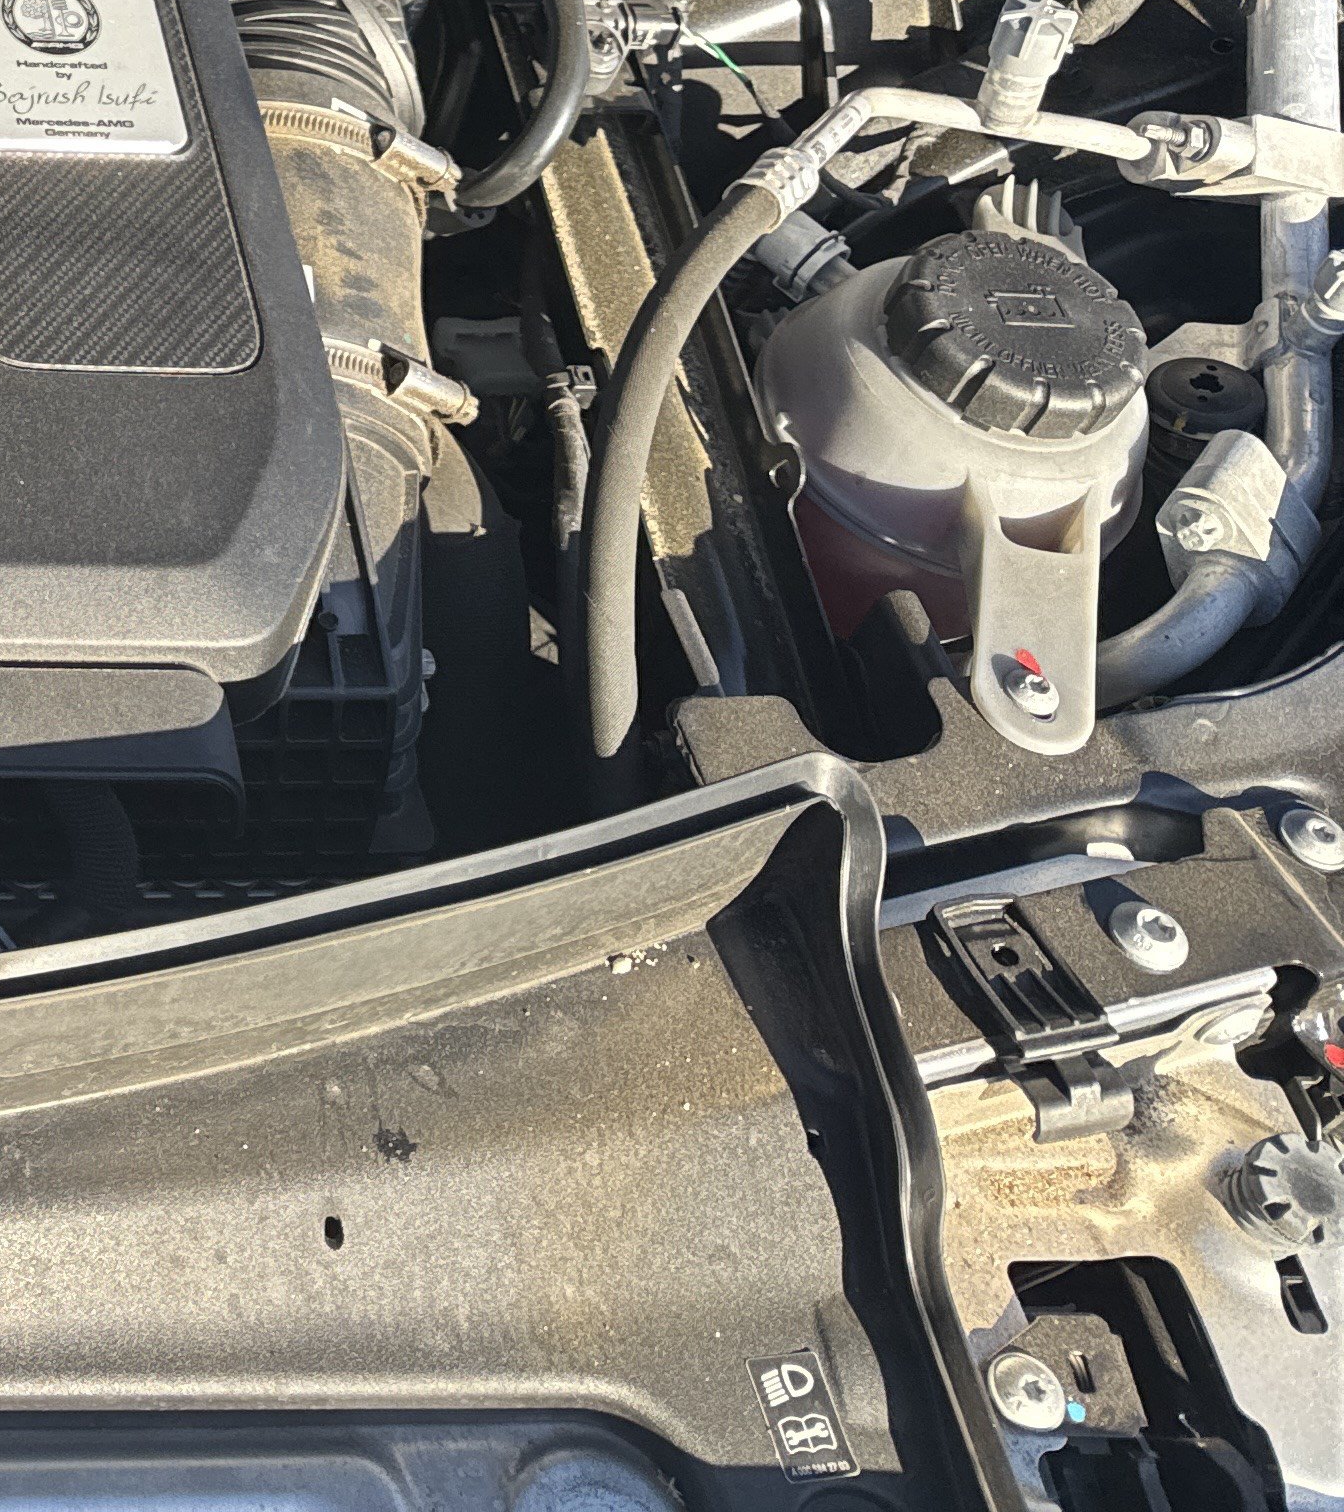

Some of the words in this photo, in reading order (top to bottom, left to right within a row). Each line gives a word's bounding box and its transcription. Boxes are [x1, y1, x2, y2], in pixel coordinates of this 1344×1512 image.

[16, 59, 108, 71] Handcrafted
[55, 71, 72, 80] by
[16, 117, 135, 129] Mercedes-AMG
[45, 128, 111, 139] Germany
[1016, 245, 1074, 276] WHEN
[1073, 273, 1113, 303] HOT
